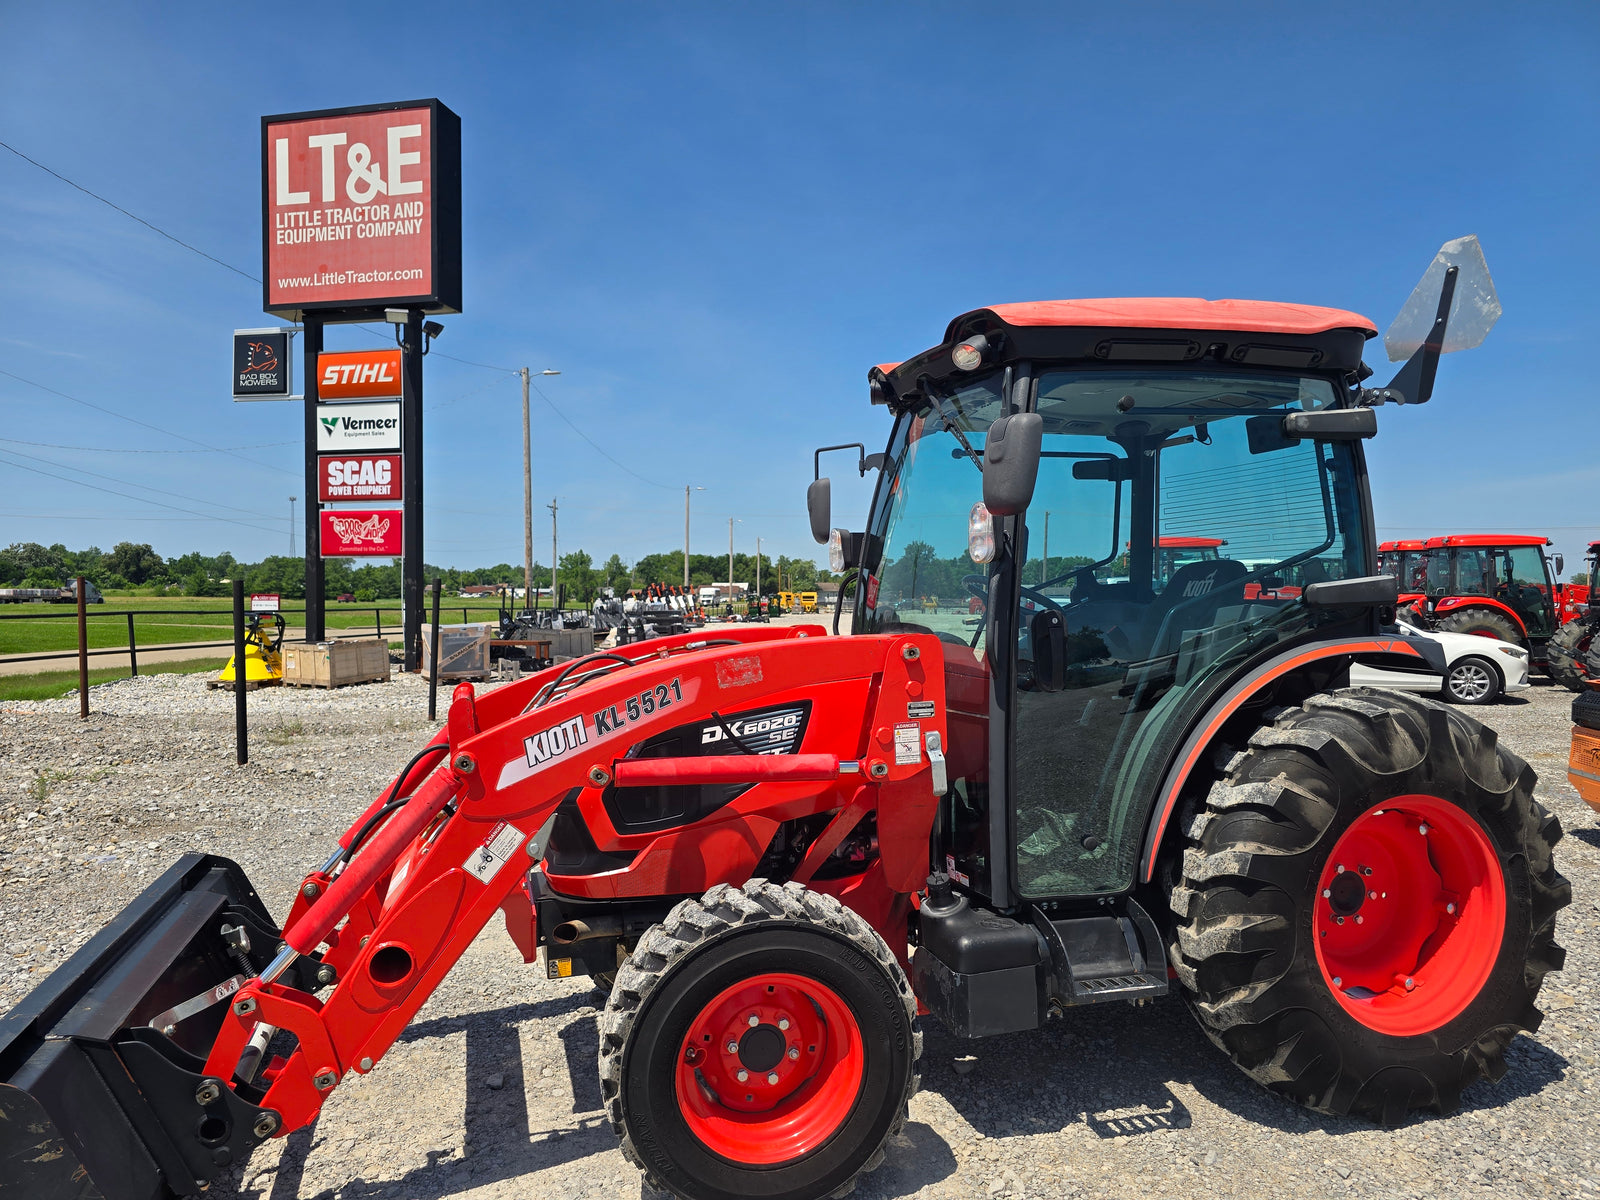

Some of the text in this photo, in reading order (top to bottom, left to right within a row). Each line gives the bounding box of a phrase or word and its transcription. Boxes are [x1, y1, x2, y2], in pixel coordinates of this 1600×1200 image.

[275, 124, 423, 206] LT&E
[276, 201, 424, 229] LITTLE TRACTOR AND
[276, 218, 423, 245] EQUIPMENT COMPANY
[278, 268, 423, 289] www.LittleTractor.com
[240, 378, 278, 387] MOWERS
[259, 372, 278, 380] BOY
[321, 362, 394, 386] STIHL
[342, 416, 397, 430] Vermeer
[327, 459, 391, 486] SCAG
[328, 485, 391, 496] POWER EQUIPMENT
[1182, 576, 1215, 597] KIOTI
[524, 677, 684, 768] KIOTI KL 5521
[768, 728, 795, 744] SE
[488, 822, 505, 841] DANGER
[840, 948, 868, 972] HD
[866, 972, 905, 1051] 2000
